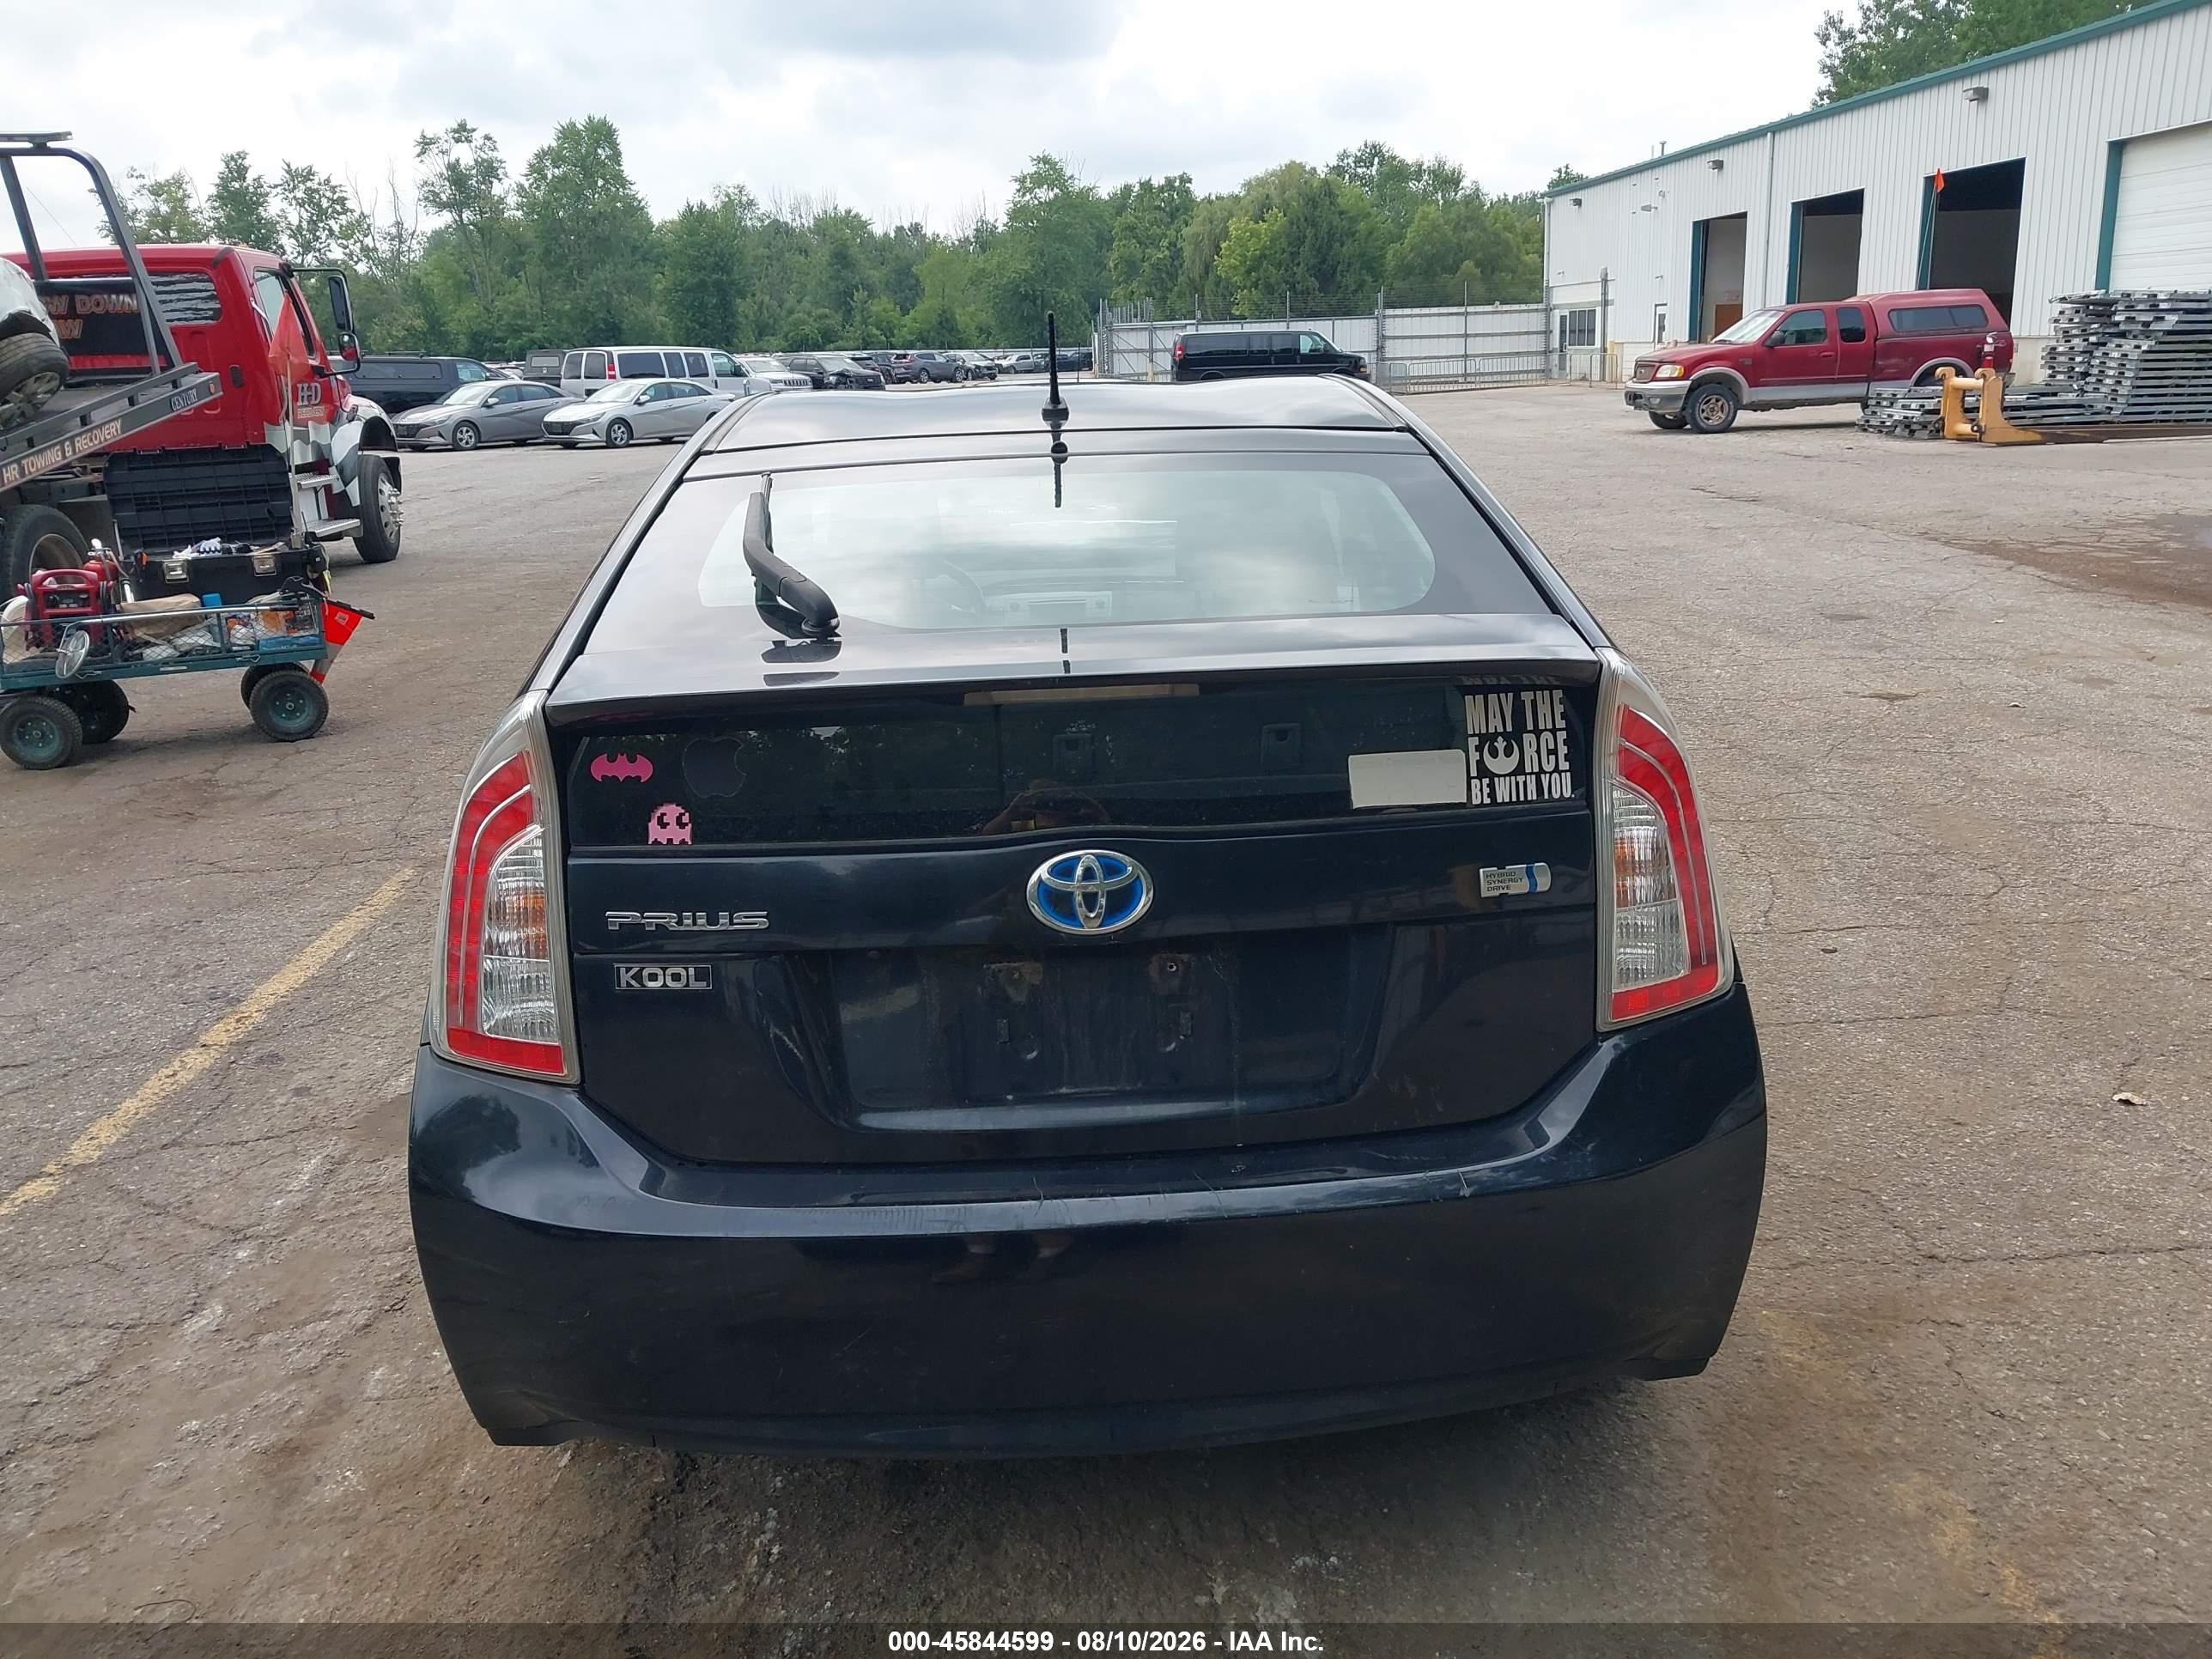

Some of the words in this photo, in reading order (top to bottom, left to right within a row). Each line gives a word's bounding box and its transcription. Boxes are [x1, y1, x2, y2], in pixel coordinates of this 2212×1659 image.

[75, 294, 139, 314] DOWN
[171, 388, 198, 411] CENTURY
[3, 465, 19, 484] HR
[21, 446, 62, 475] TOWING
[64, 441, 72, 456] &
[75, 419, 122, 452] RECOVERY
[1464, 692, 1514, 734] MAY
[1521, 690, 1566, 730] THE
[1470, 777, 1492, 805] BE
[1493, 775, 1537, 803] WITH
[1540, 771, 1576, 799] YOU.
[1486, 871, 1516, 879] HYBRID
[1486, 877, 1524, 886] SYNERGY
[605, 911, 769, 931] PRIUS
[619, 967, 708, 988] KOOL
